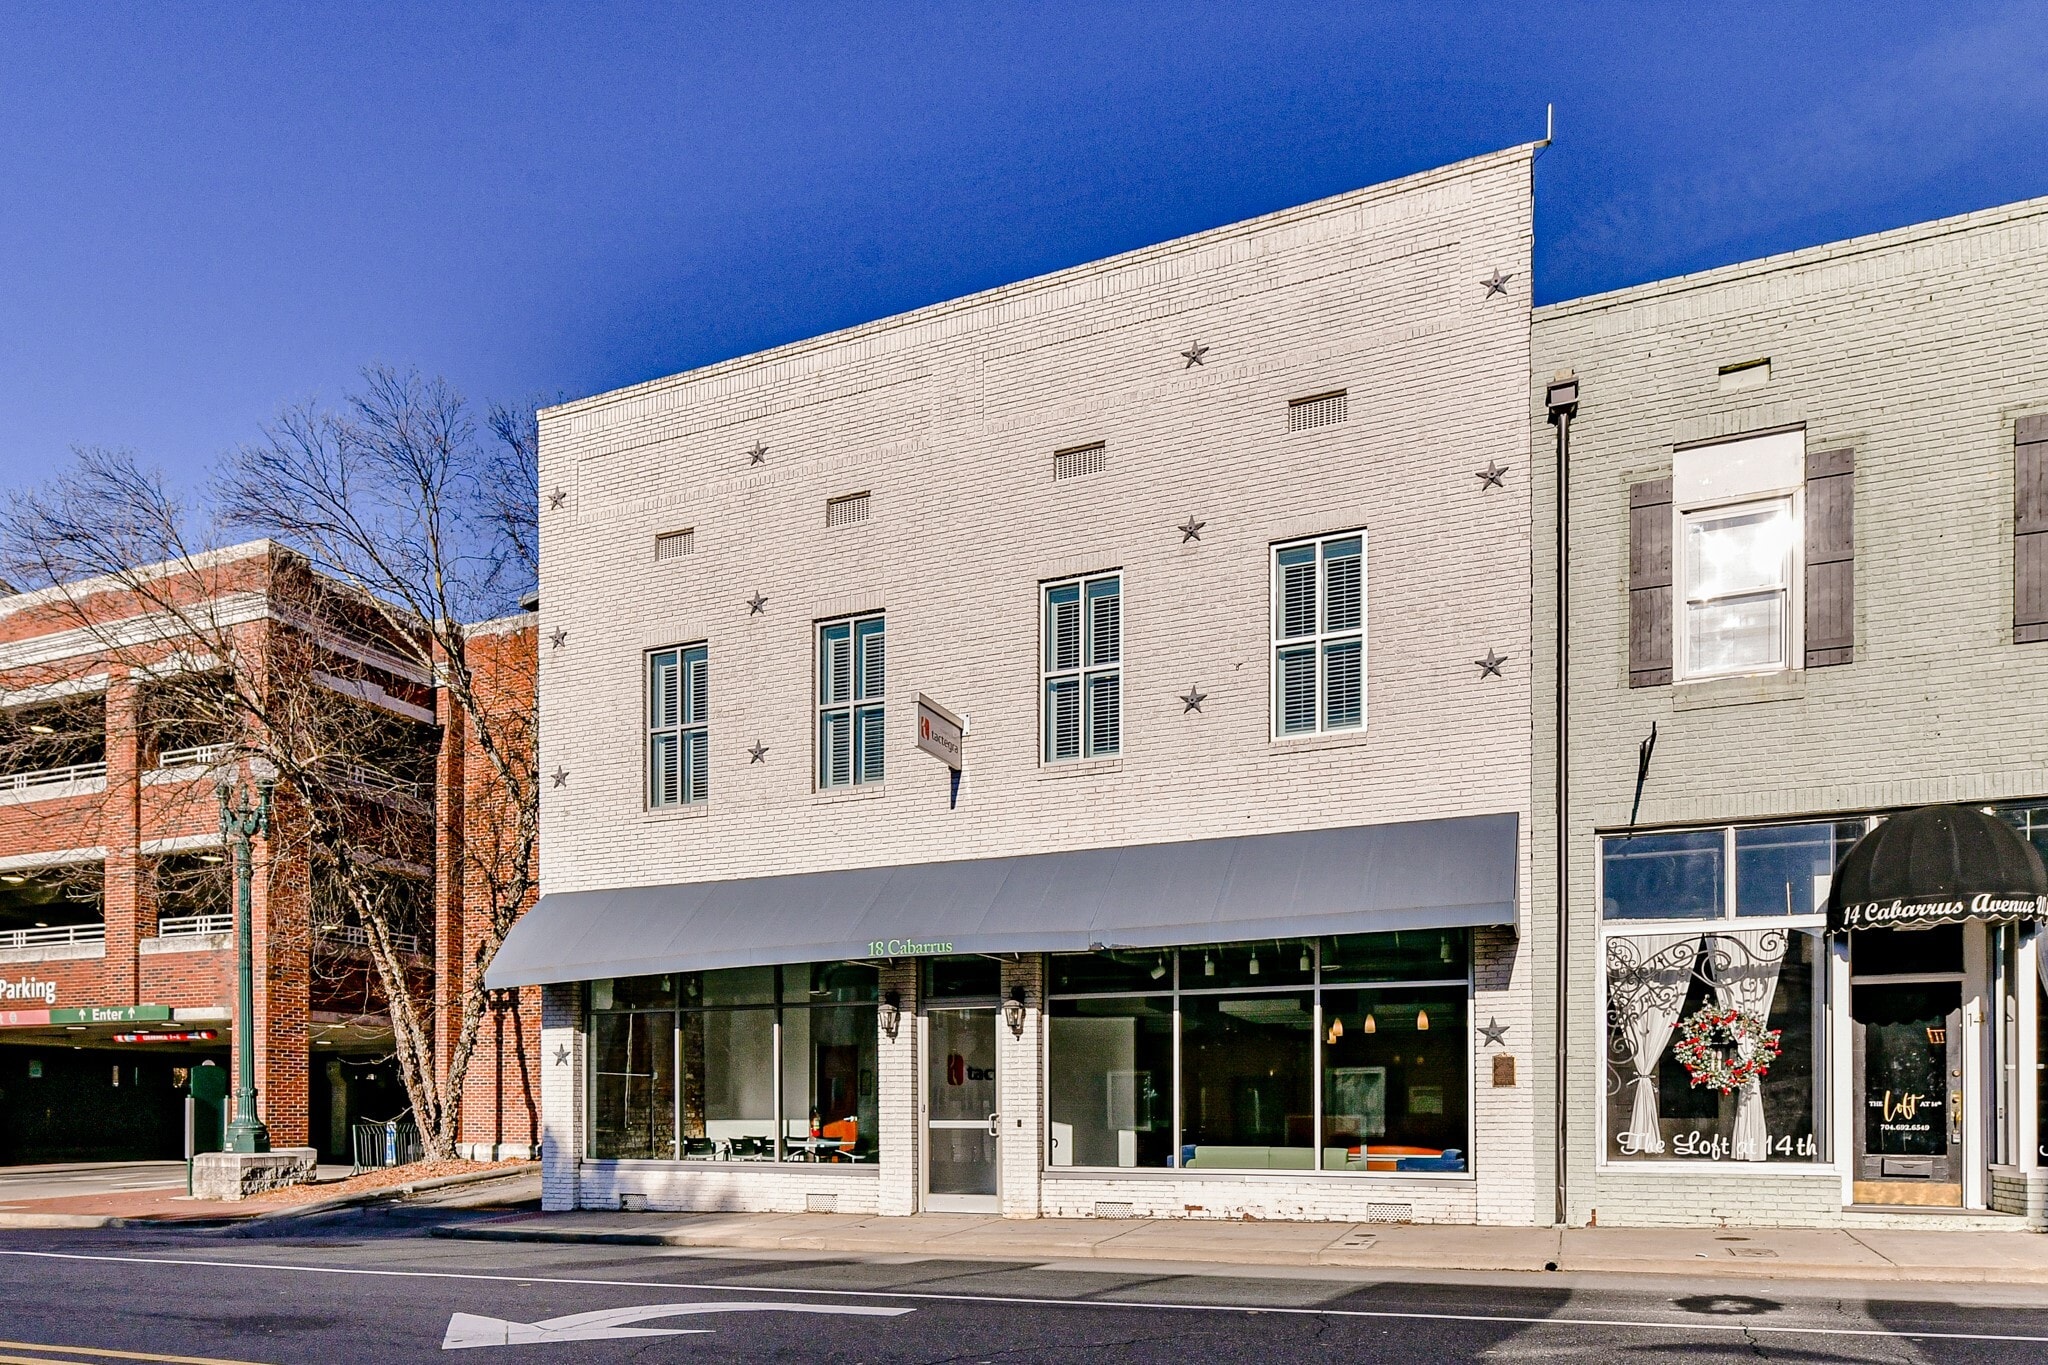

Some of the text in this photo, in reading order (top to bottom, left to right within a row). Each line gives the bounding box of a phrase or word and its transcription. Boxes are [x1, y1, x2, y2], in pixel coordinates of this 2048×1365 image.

[931, 730, 959, 754] tactegra
[1843, 904, 1861, 925] 14
[1864, 899, 1964, 922] Cabarrus
[1971, 893, 2035, 913] Avenue
[868, 939, 953, 956] 18 Cabarrus
[0, 976, 57, 1004] Parking
[92, 1008, 124, 1021] Enter
[966, 1065, 995, 1081] tac
[1616, 1131, 1665, 1155] The
[1673, 1130, 1730, 1160] Loft
[1737, 1136, 1757, 1155] at
